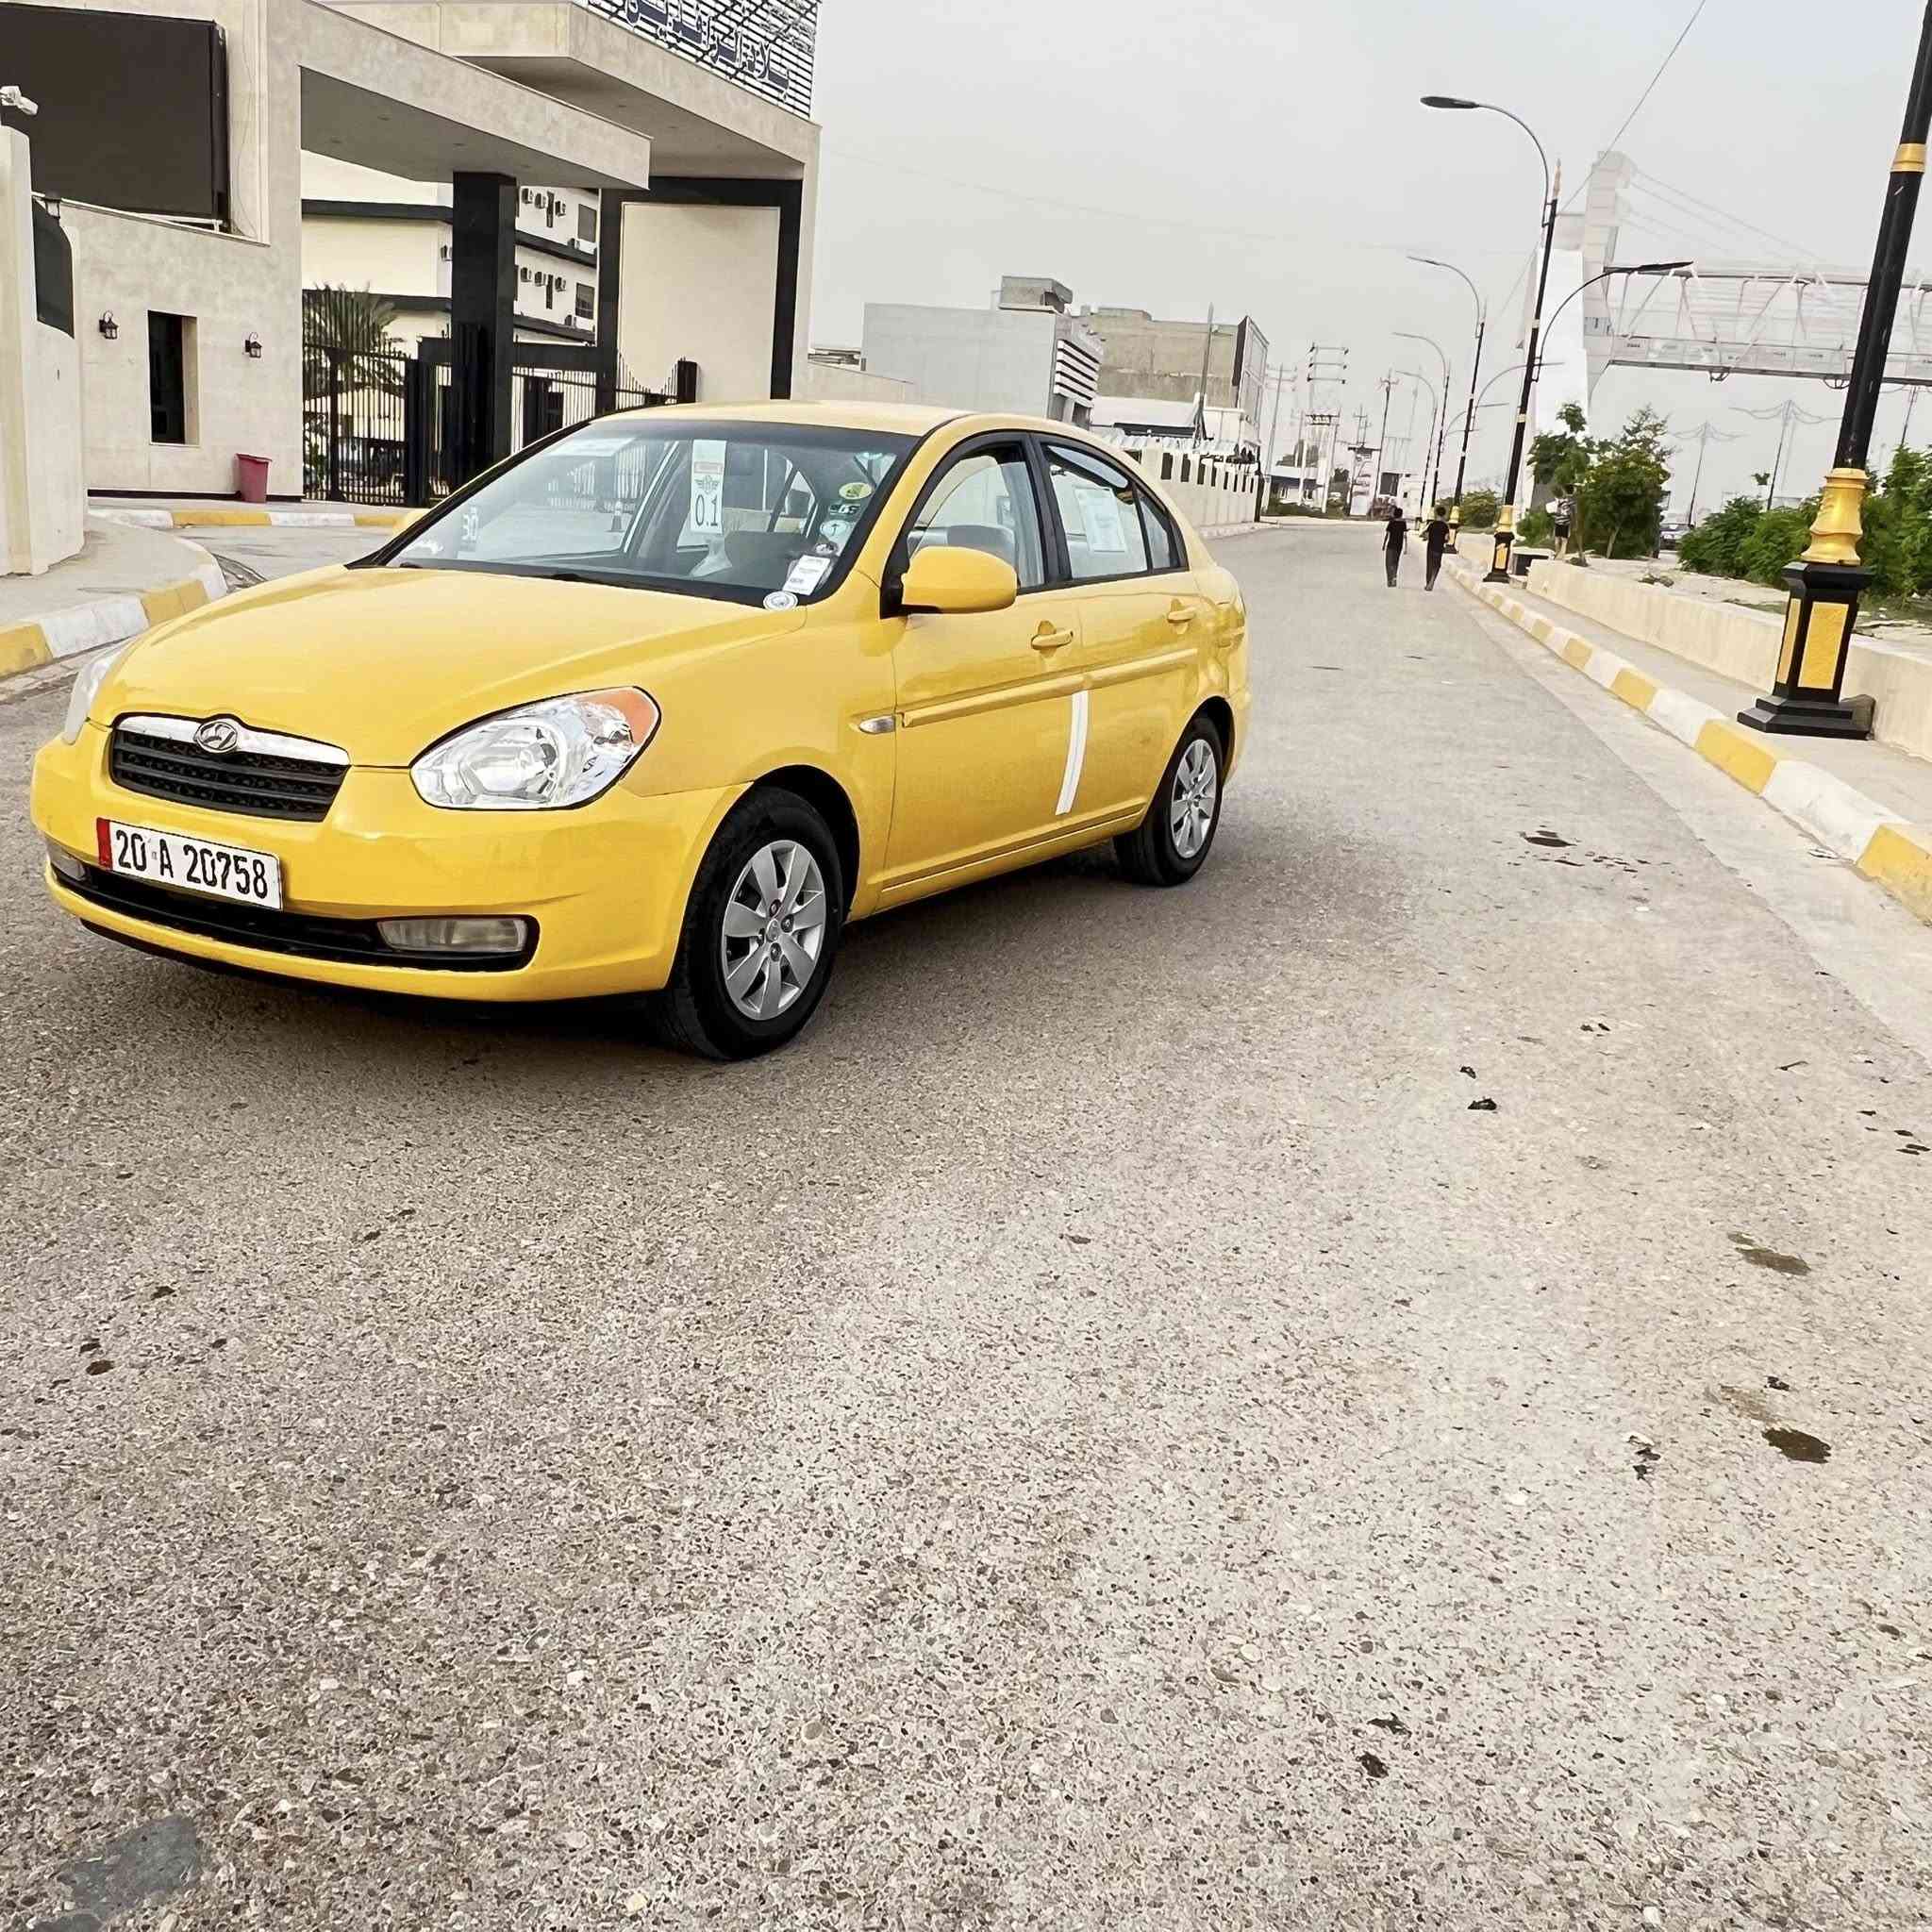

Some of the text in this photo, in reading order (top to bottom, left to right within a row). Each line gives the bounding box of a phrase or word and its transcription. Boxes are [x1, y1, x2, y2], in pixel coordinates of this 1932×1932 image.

[116, 830, 268, 899] 20 A 20758
